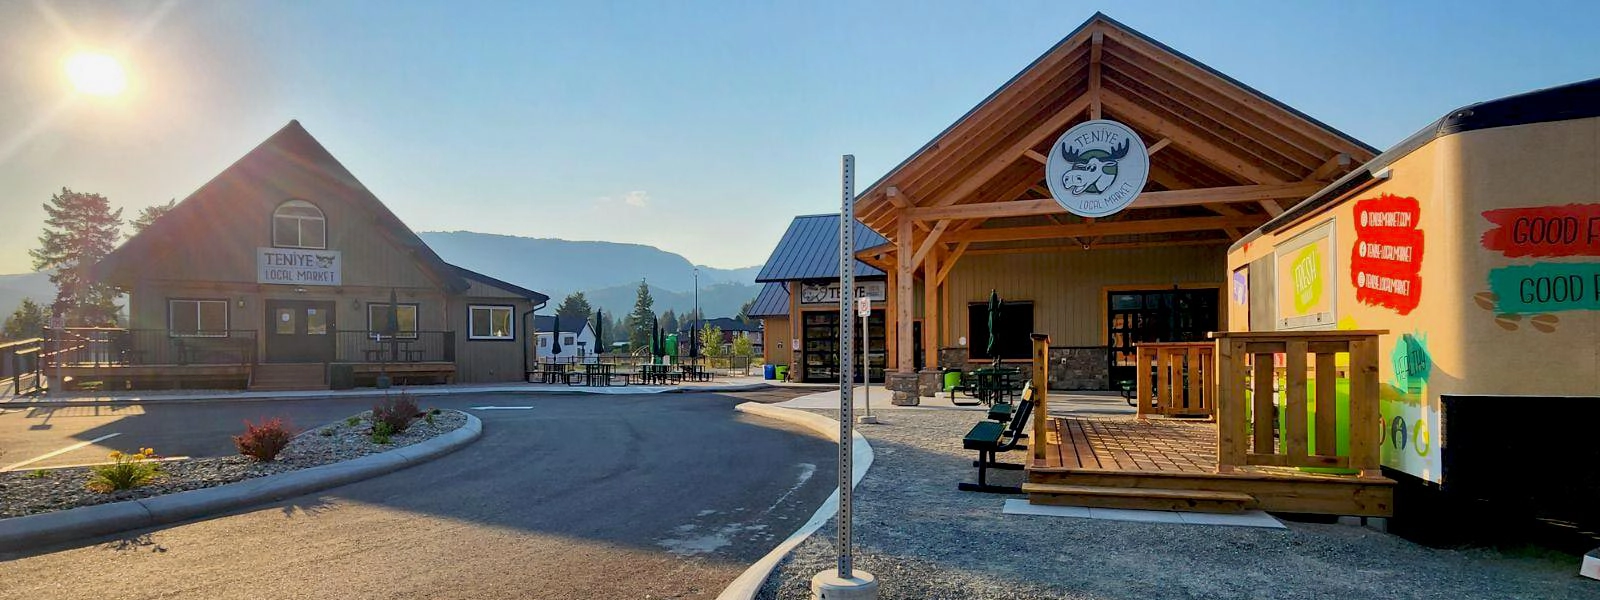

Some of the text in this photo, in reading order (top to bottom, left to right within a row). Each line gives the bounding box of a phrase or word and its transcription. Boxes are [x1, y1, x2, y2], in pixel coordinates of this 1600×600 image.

[1080, 182, 1133, 211] LOCAL MARKET
[1514, 216, 1579, 245] GOOD
[265, 269, 335, 283] LOCAL MARKET
[1295, 249, 1317, 293] FRESH
[828, 286, 865, 298] TEYE
[1519, 274, 1584, 304] GOOD
